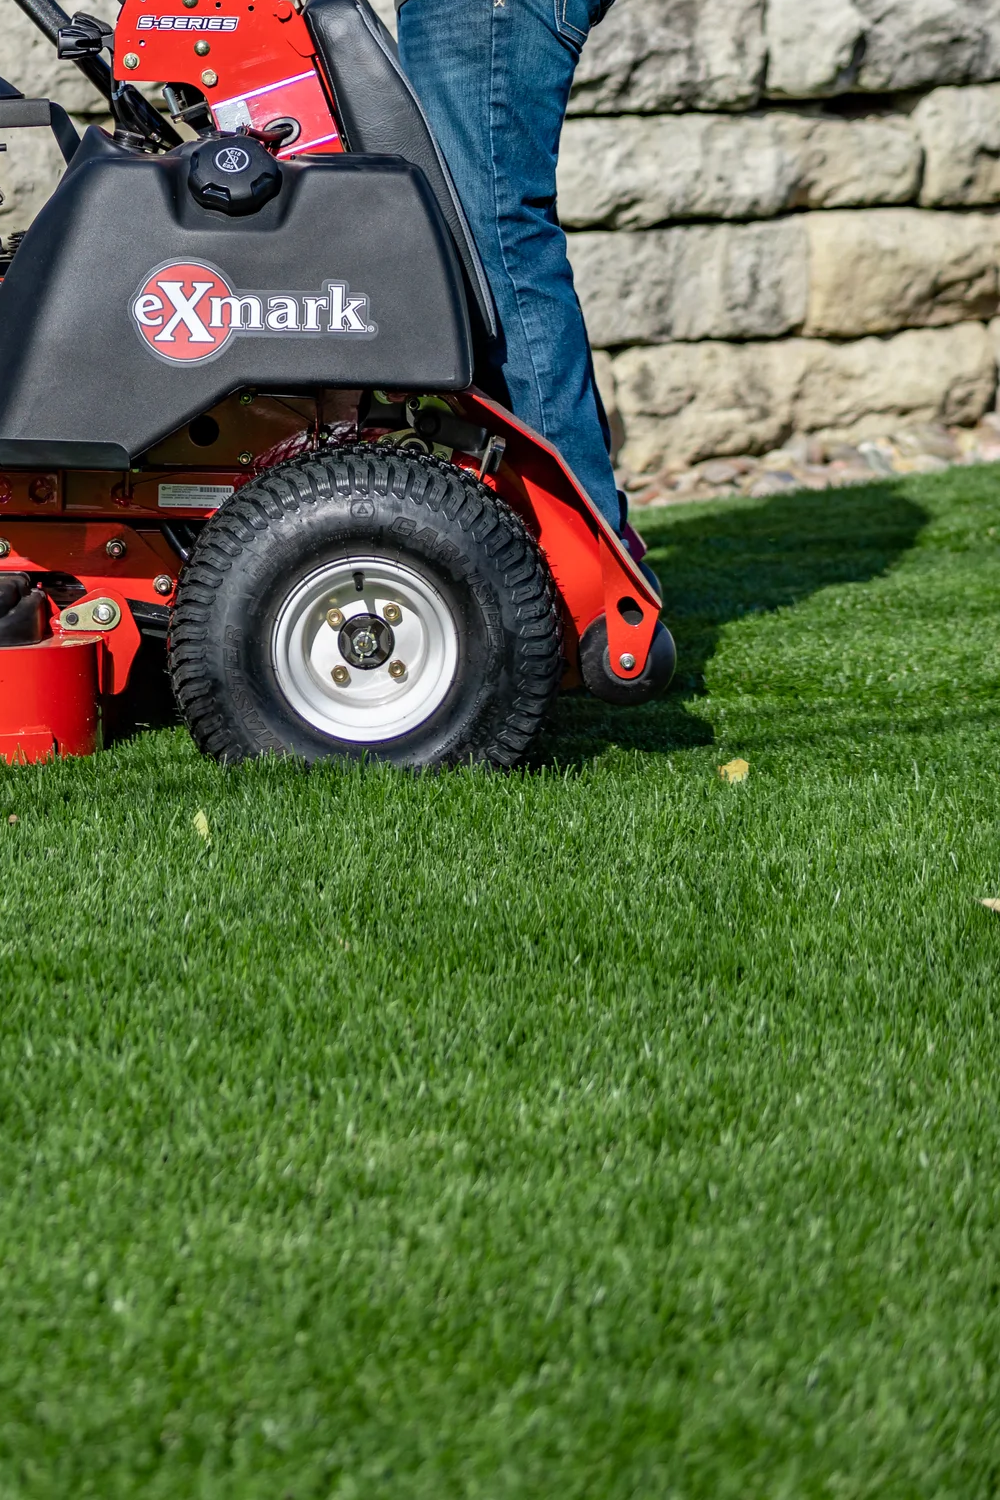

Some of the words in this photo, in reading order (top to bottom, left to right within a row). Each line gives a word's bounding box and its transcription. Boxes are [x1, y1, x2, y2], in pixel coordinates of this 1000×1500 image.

[137, 16, 239, 31] S-SERIES
[134, 280, 368, 343] eXmark
[389, 516, 506, 648] CARLISLE
